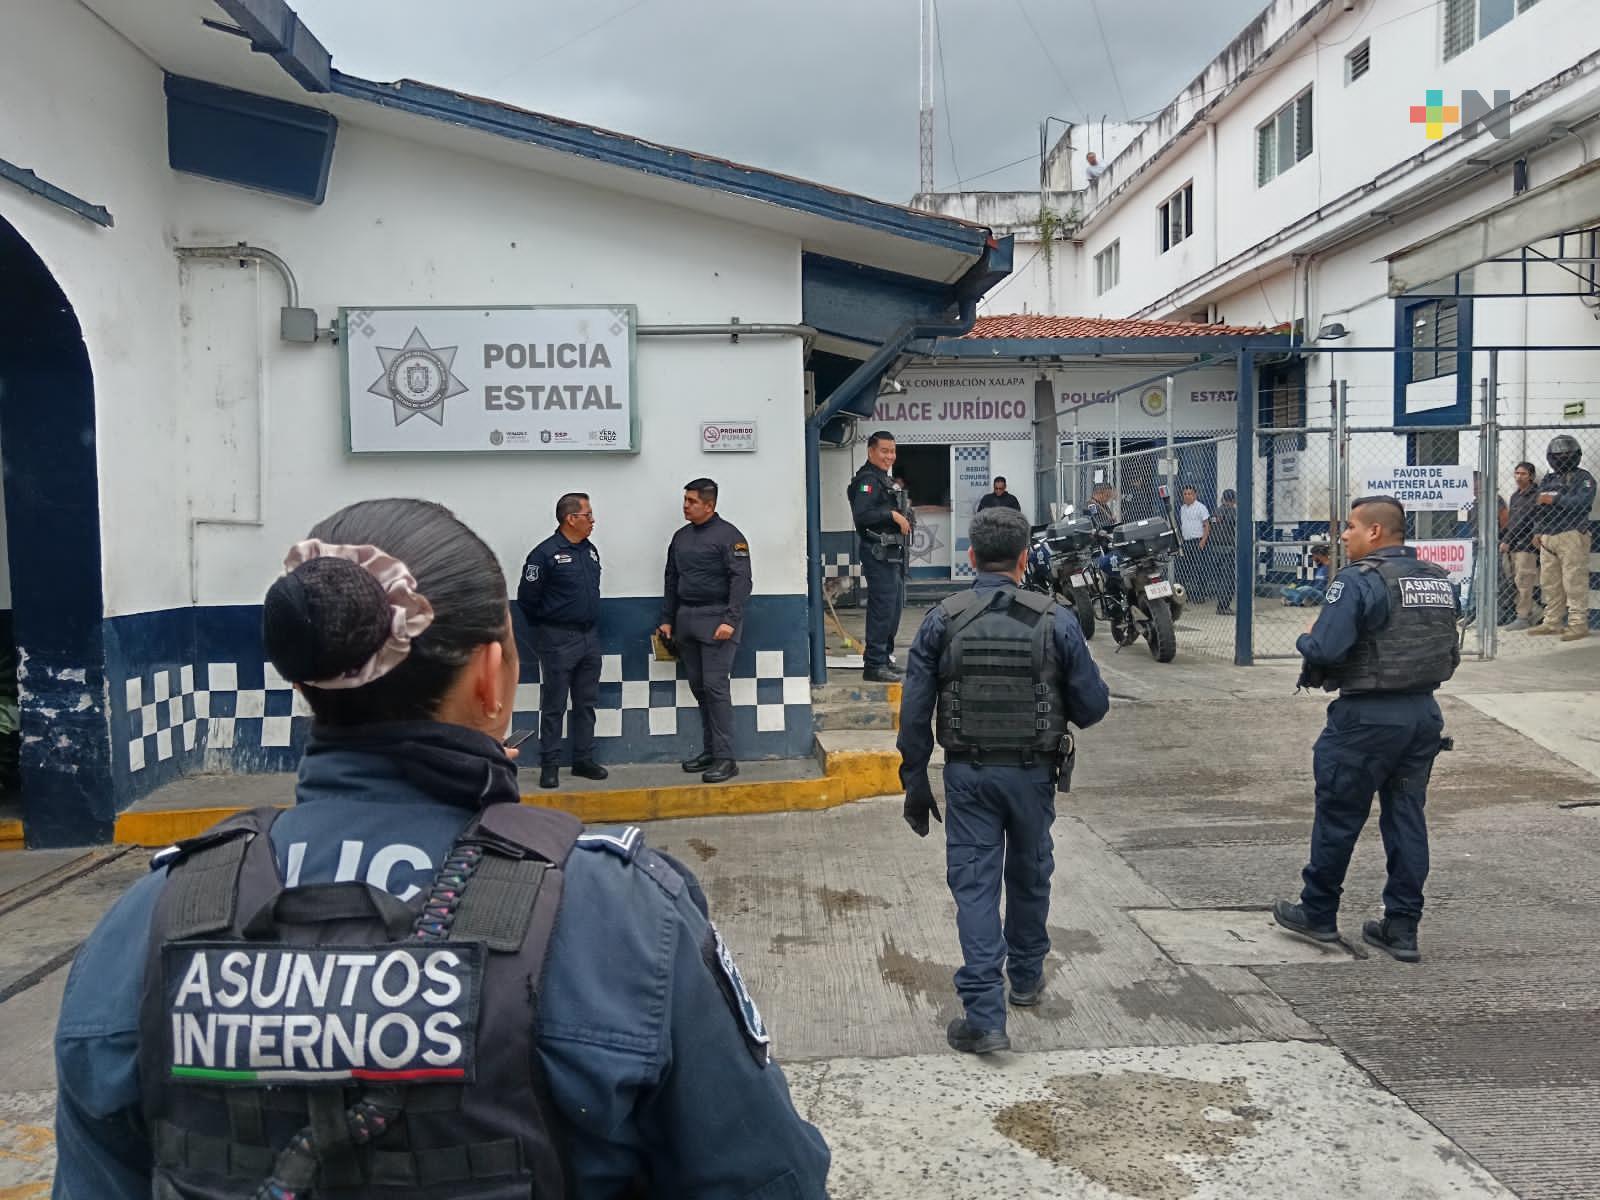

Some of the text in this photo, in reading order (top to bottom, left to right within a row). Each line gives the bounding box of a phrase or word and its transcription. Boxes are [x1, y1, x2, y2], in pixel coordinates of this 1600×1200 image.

[483, 342, 612, 369] POLICIA
[988, 377, 1025, 386] XALAPA
[484, 384, 623, 411] ESTATAL
[859, 396, 1027, 422] NLACE JURÍDICO
[1393, 468, 1443, 478] FAVOR DE
[1367, 479, 1468, 490] MANTENER LA REJA
[1394, 490, 1443, 500] CERRADA
[1416, 545, 1465, 562] ROHIBIDO
[1405, 581, 1453, 592] ASUNTOS
[1405, 592, 1453, 604] INTERNOS
[175, 950, 462, 1008] ASUNTOS
[172, 1012, 463, 1069] INTERNOS
